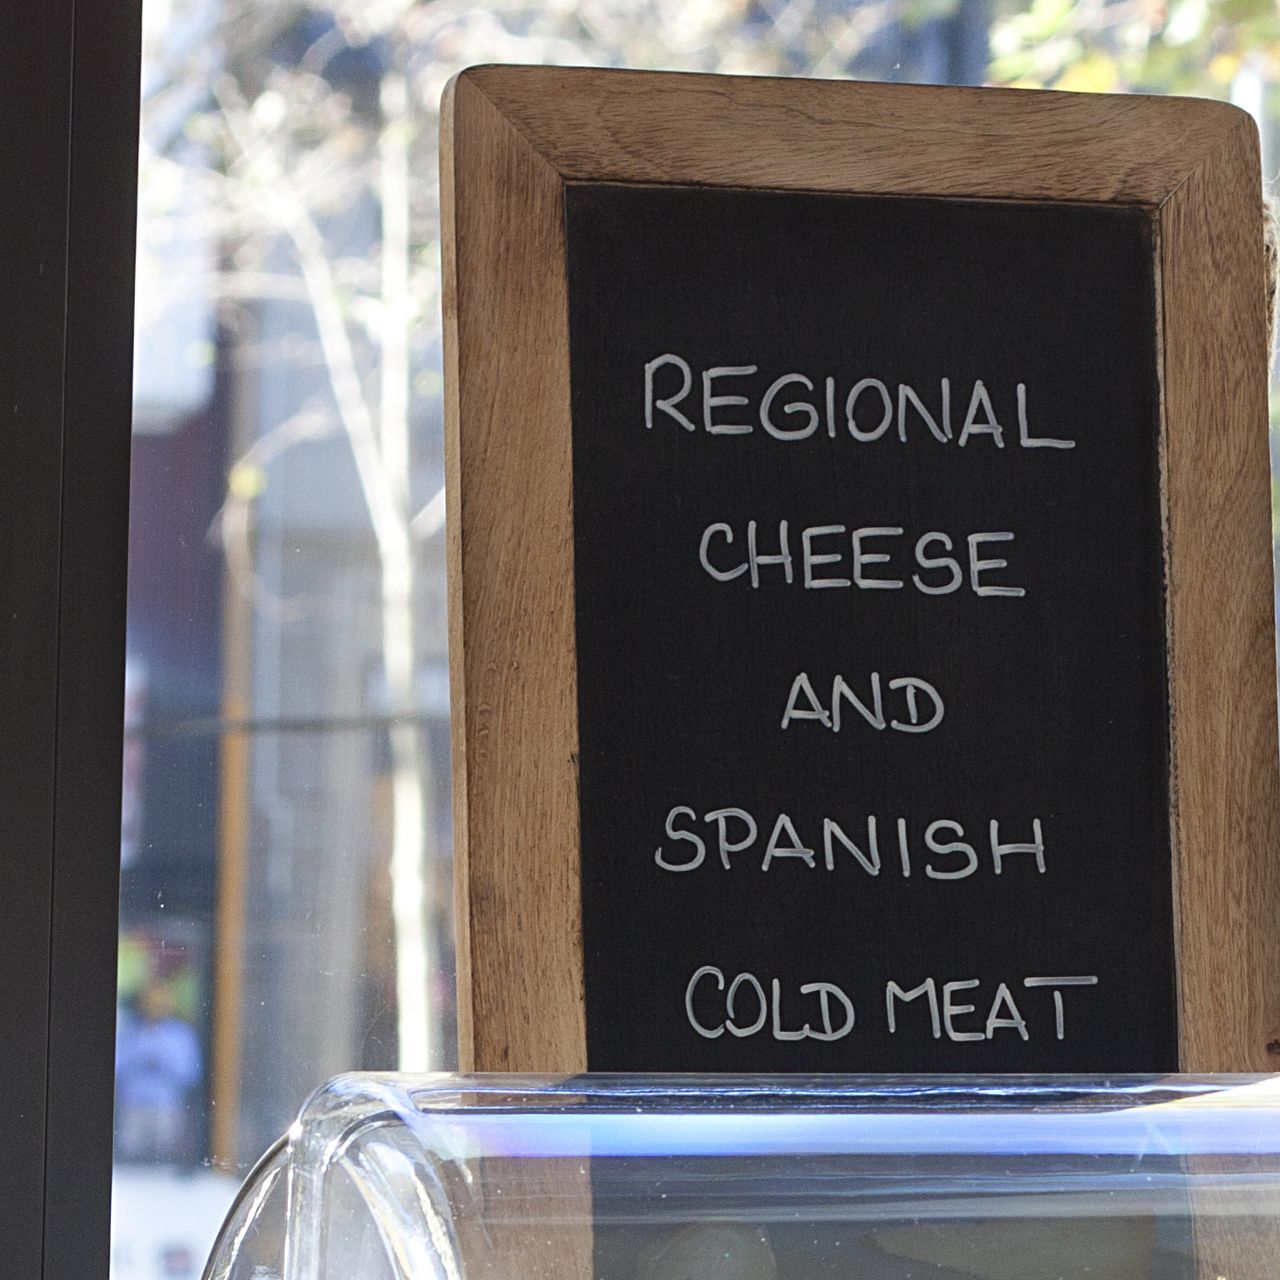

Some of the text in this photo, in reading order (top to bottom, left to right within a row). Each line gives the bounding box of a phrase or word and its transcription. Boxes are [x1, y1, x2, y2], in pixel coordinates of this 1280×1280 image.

[644, 353, 1076, 448] REGIONAL
[699, 519, 1026, 598] CHEESE
[780, 672, 946, 733] AND
[654, 805, 1047, 881] SPANISH
[685, 965, 1098, 1042] COLD MEAT
